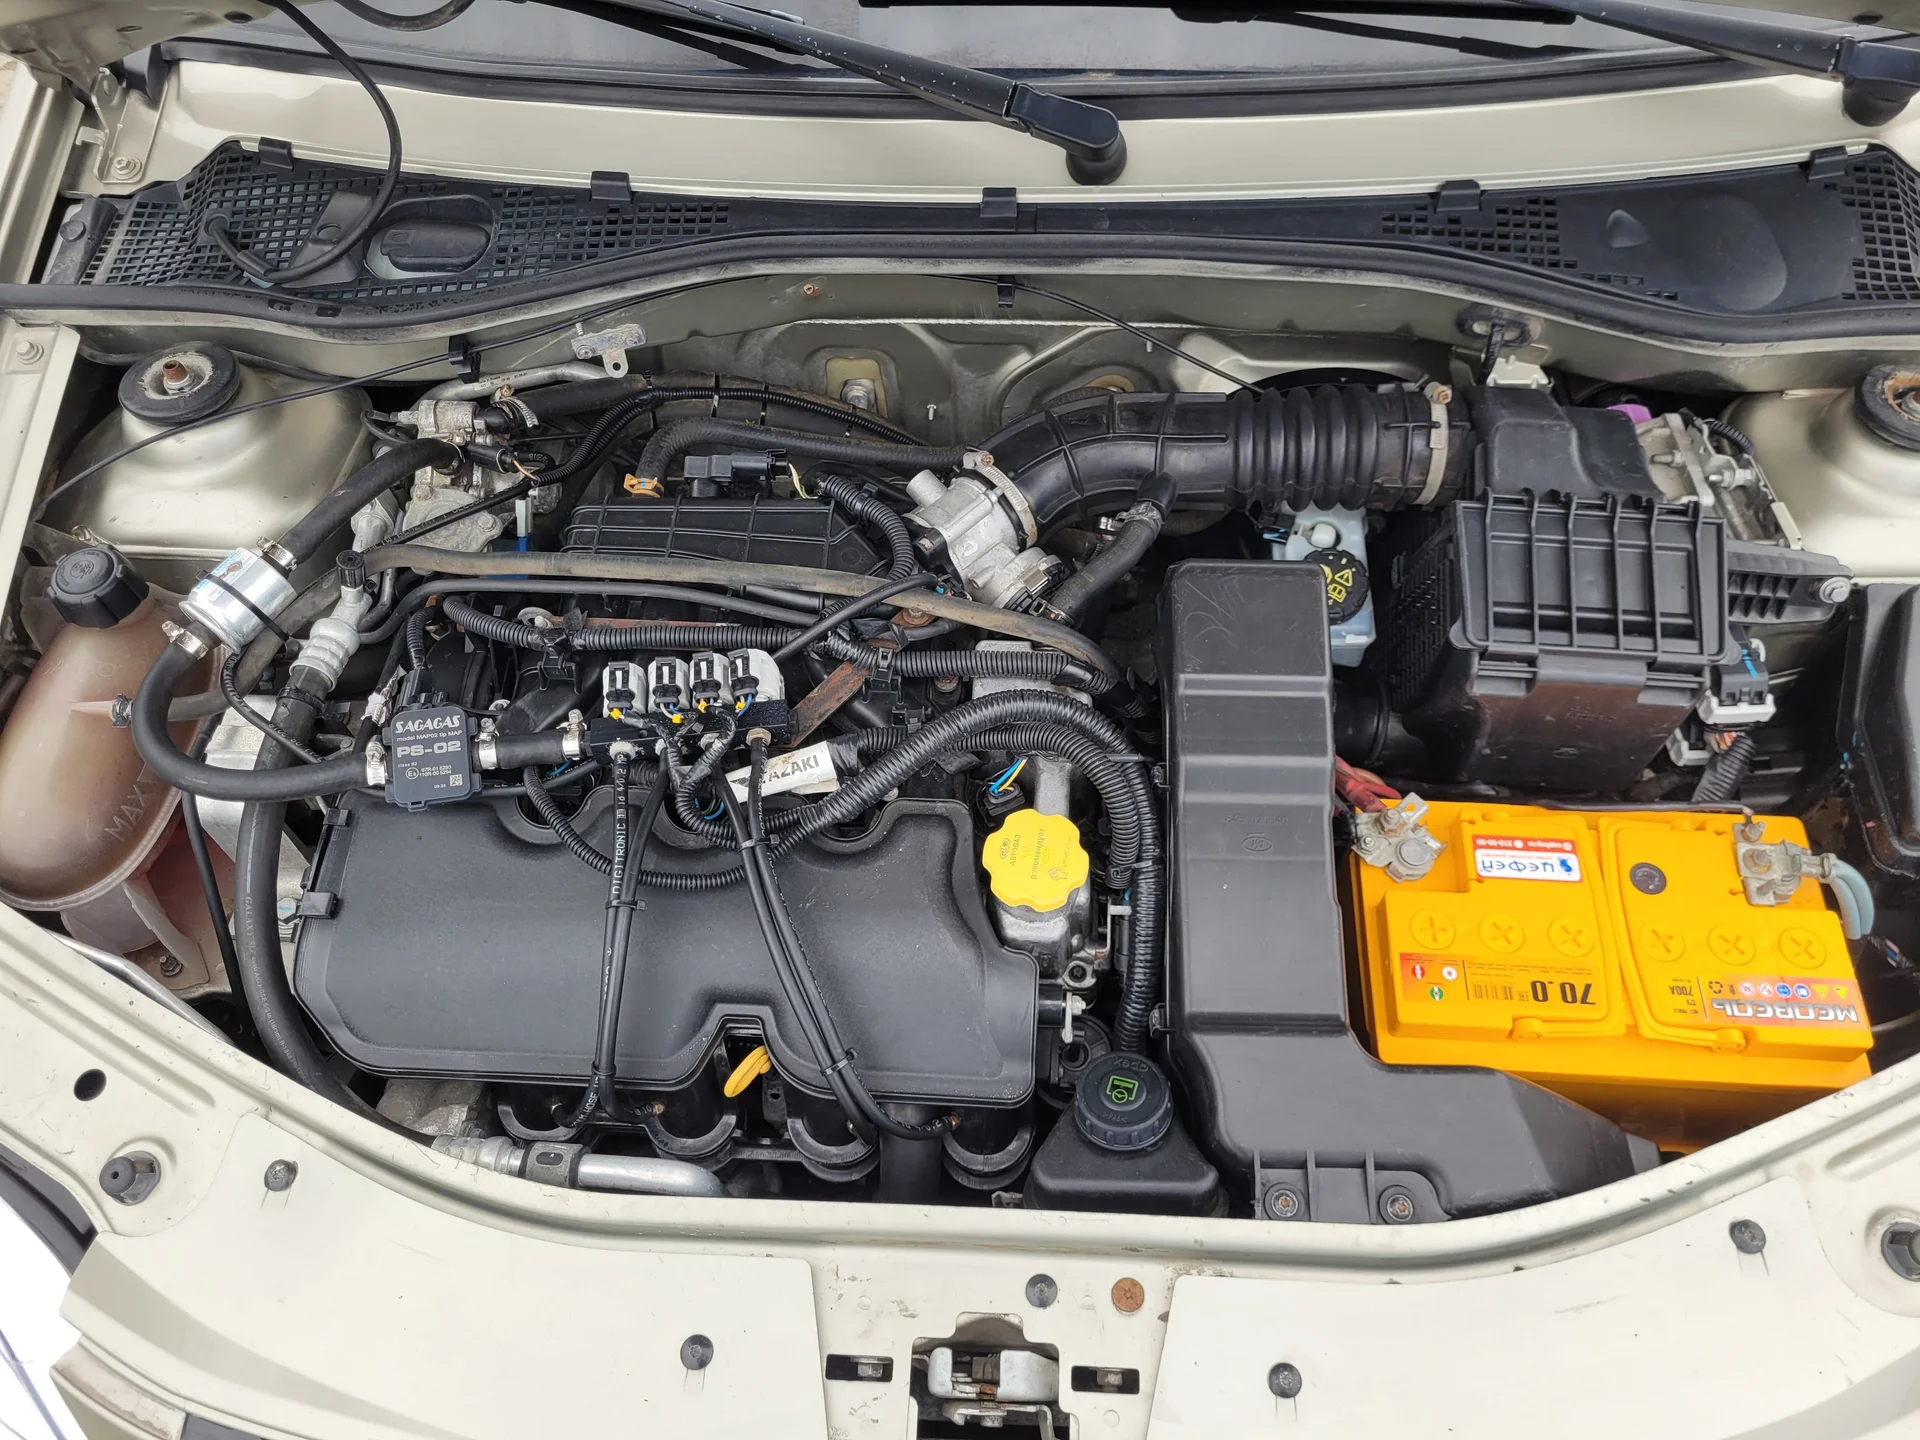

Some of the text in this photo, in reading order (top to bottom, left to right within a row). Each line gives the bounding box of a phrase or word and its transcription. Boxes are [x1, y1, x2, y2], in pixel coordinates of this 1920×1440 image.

[395, 715, 461, 734] SAGAGAS
[396, 734, 416, 742] model
[416, 732, 439, 740] MAP02
[448, 729, 463, 737] MAP
[396, 740, 462, 758] PS-02
[763, 754, 820, 785] AZAKI
[103, 782, 150, 842] MAX
[611, 823, 626, 895] DIGITRONIC
[244, 896, 255, 937] GALAXY
[583, 1091, 598, 1113] HOSE
